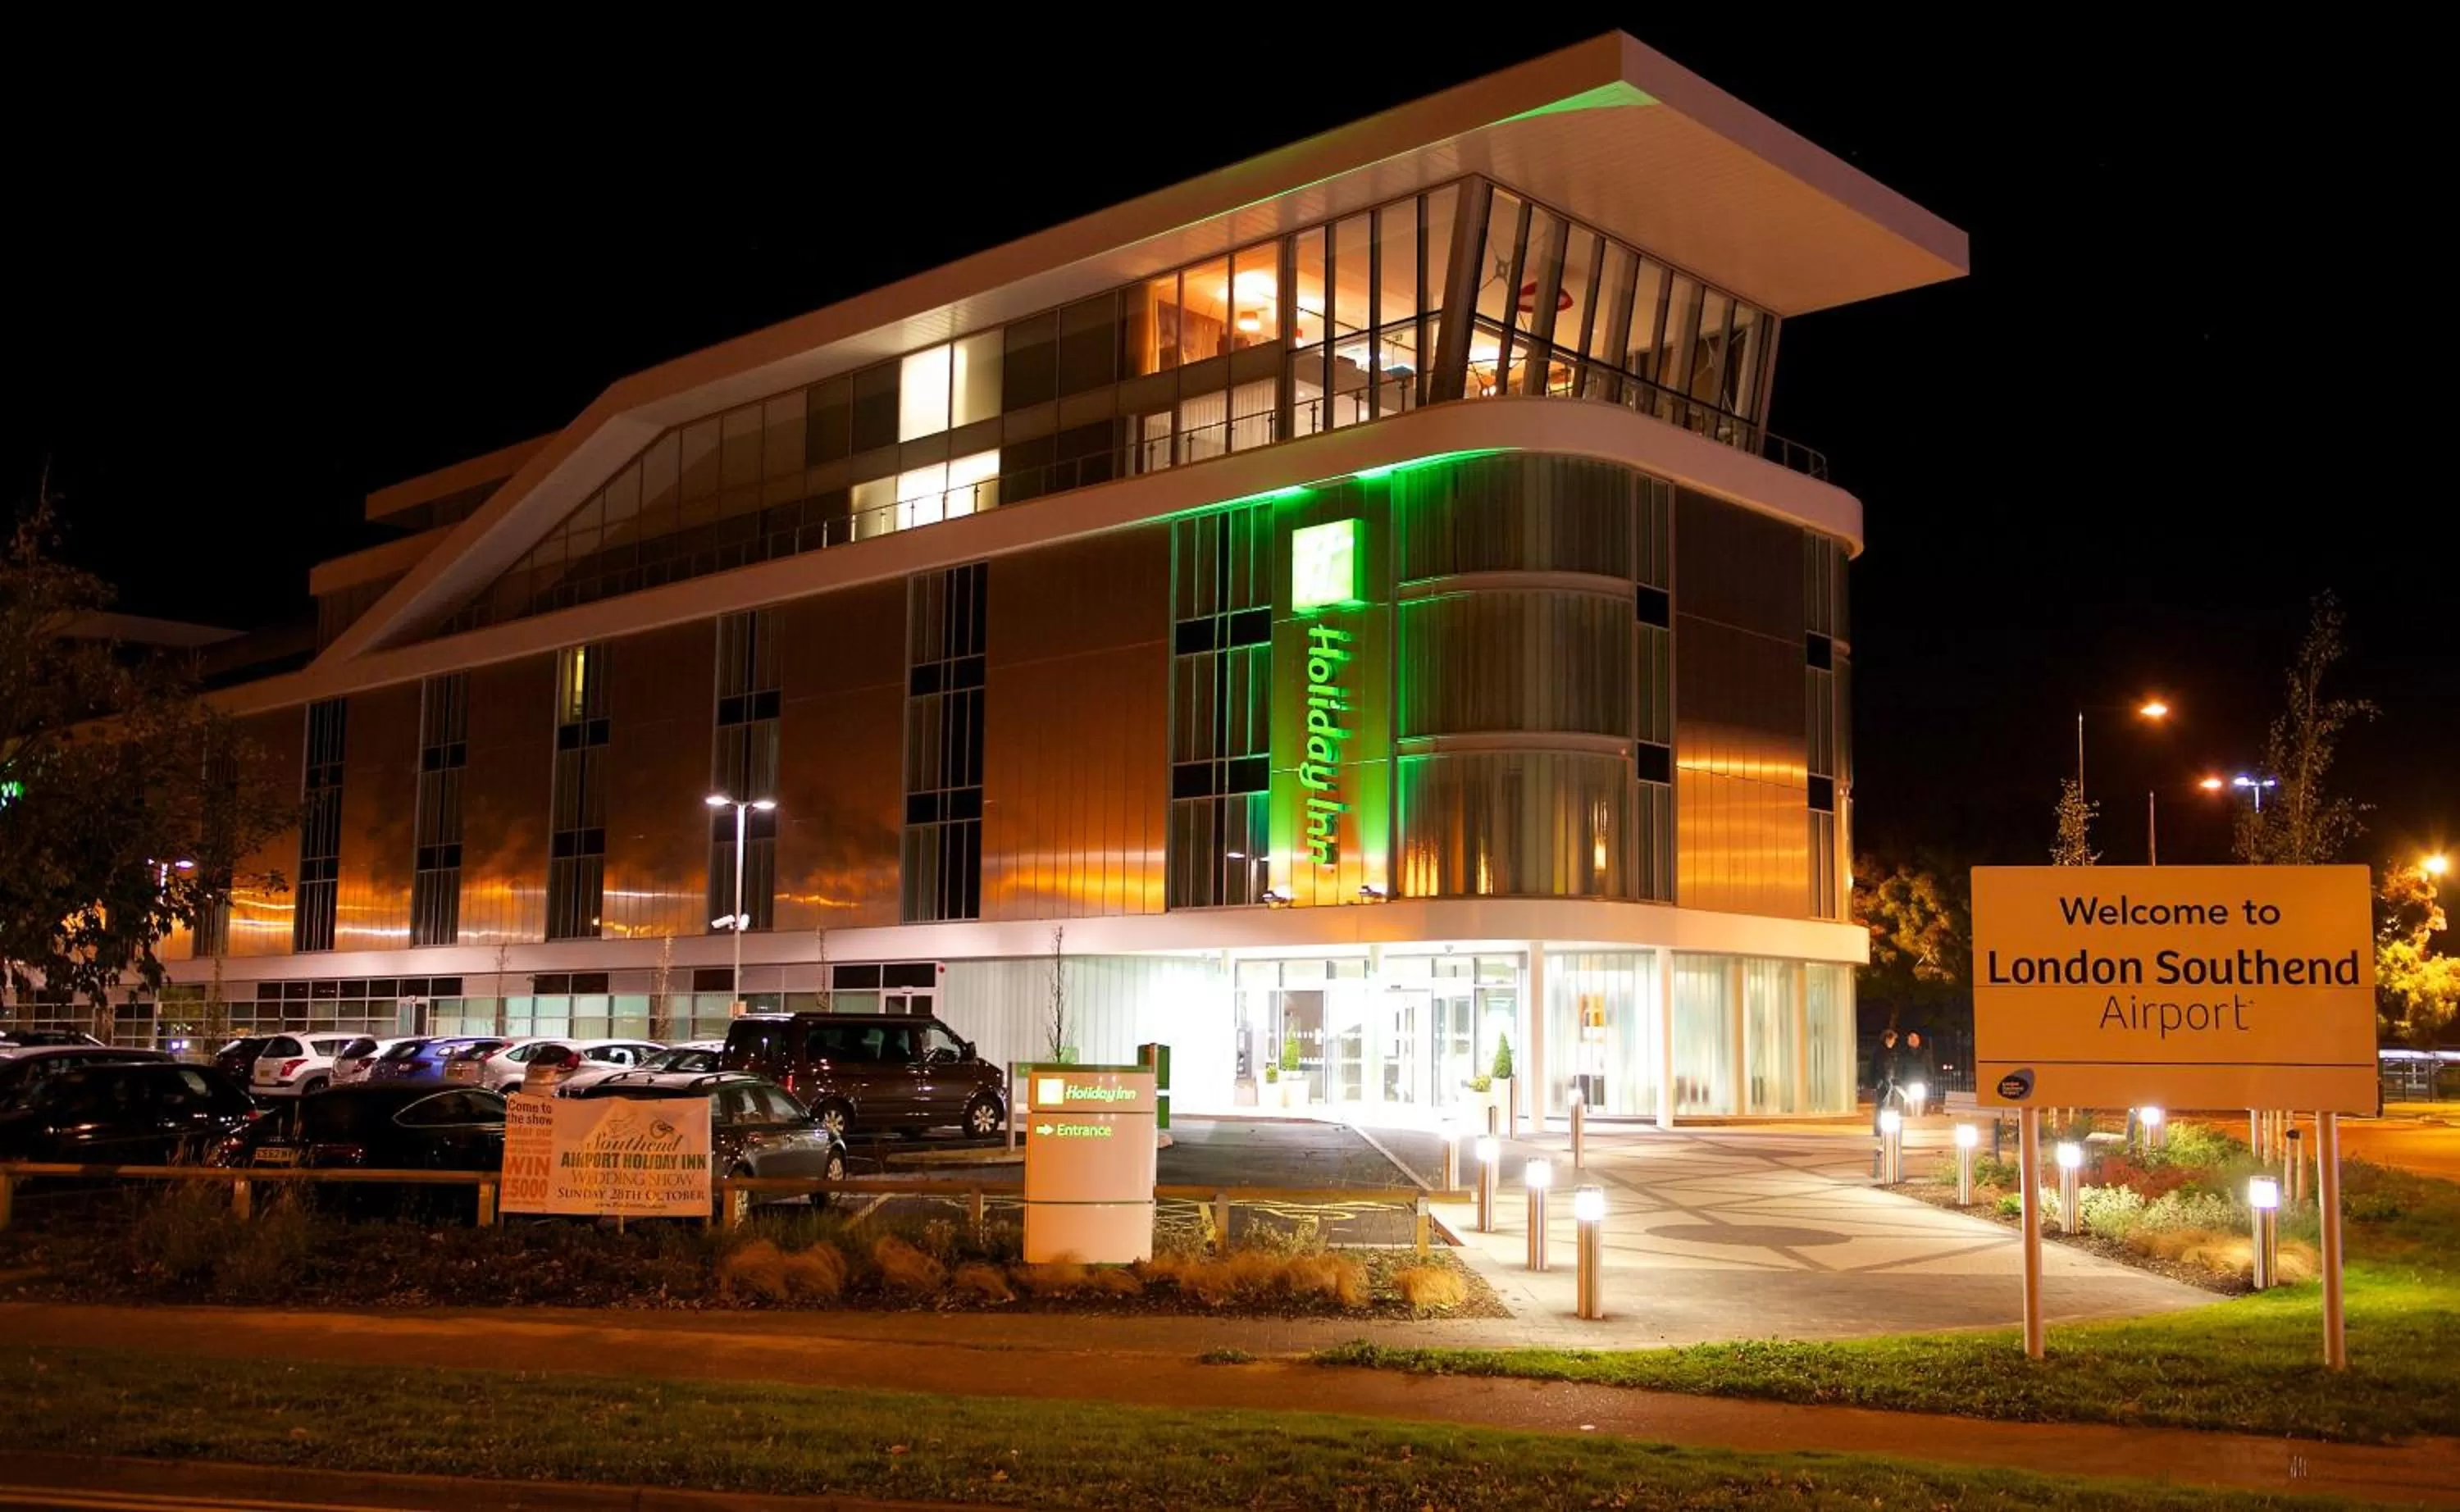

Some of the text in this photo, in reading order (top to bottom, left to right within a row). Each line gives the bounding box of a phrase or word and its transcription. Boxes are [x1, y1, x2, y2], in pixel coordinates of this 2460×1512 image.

[1299, 623, 1345, 865] Holiday Inn
[2059, 895, 2281, 926] Welcome to
[1988, 949, 2360, 986] London Southend
[2099, 992, 2251, 1041] Airport
[1066, 1084, 1116, 1103] Holiday
[508, 1099, 553, 1114] Come to
[507, 1113, 554, 1126] the show
[1056, 1123, 1113, 1137] Entrance
[585, 1132, 684, 1153] Southend
[505, 1155, 551, 1177] WIN
[561, 1151, 621, 1169] AIRPORT
[622, 1153, 678, 1170] HOLIDAY
[681, 1154, 707, 1171] INN
[572, 1168, 697, 1187] WEDDING SHOW
[558, 1186, 705, 1202] SUNDAY 28TH OCTOBER
